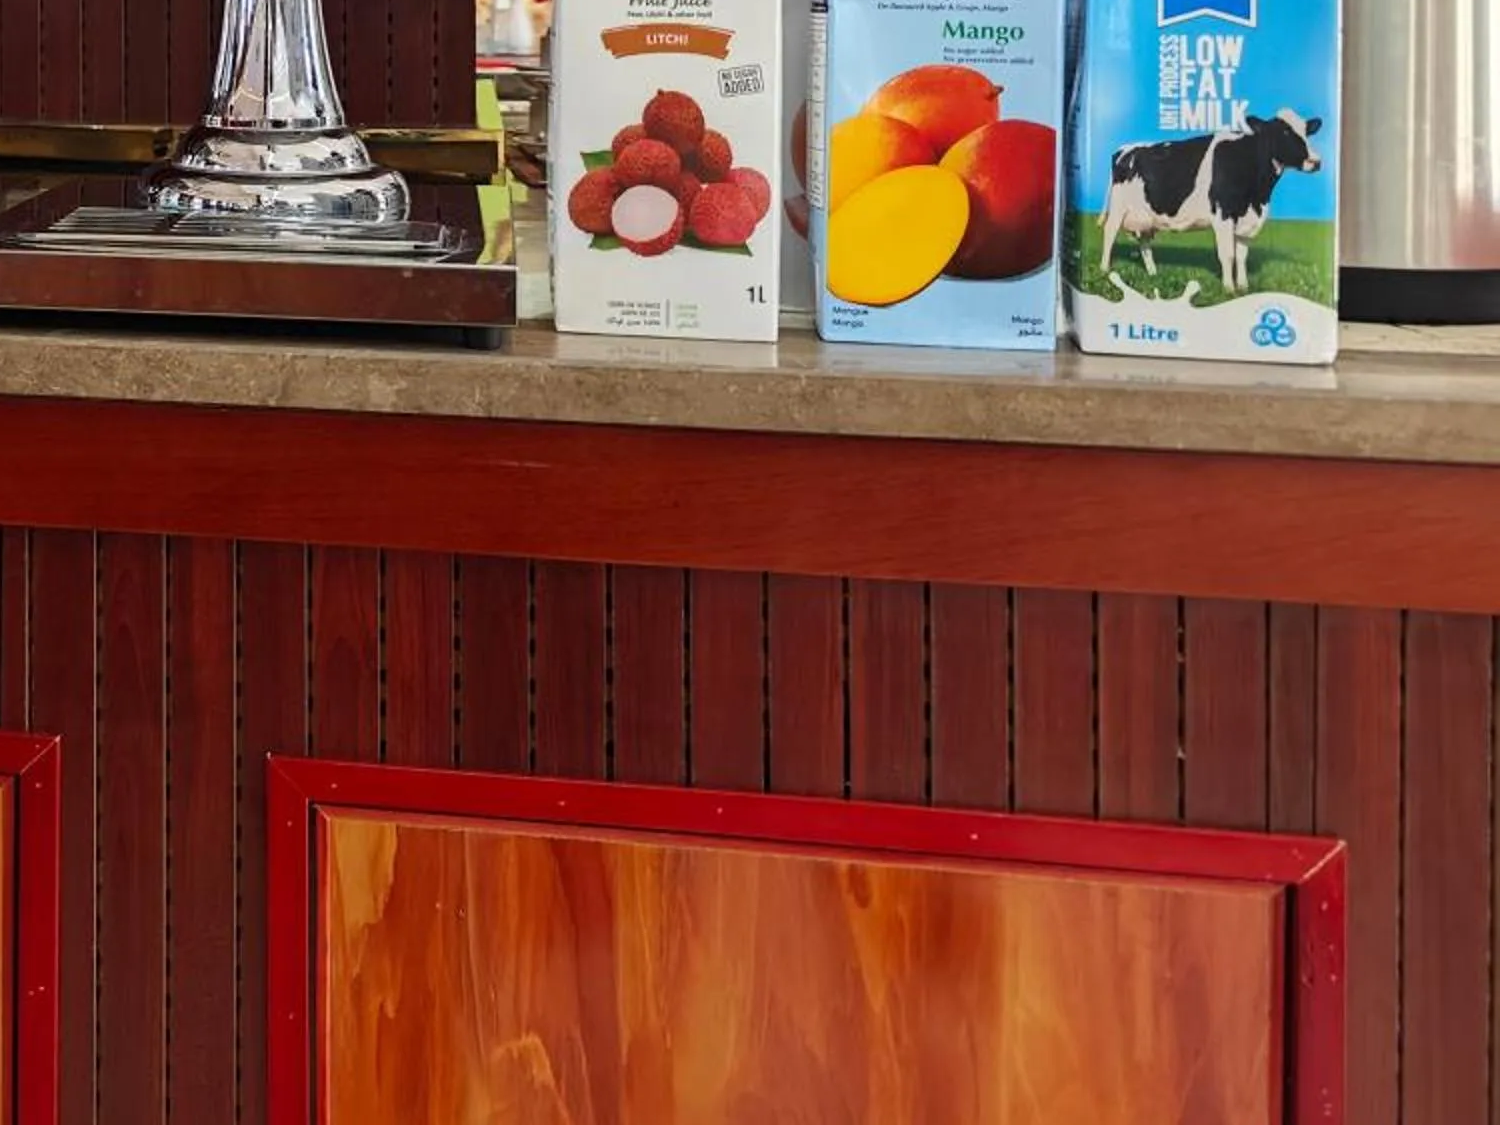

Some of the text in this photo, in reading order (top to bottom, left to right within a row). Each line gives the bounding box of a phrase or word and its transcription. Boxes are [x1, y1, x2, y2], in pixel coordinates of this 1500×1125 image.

[645, 33, 689, 46] LITCHI
[942, 20, 1024, 45] Mango
[1159, 34, 1179, 98] PROCESS
[1180, 34, 1244, 68] LOW
[1180, 67, 1237, 99] FAT
[1180, 99, 1255, 136] MILK
[1108, 323, 1179, 342] 1 Litre
